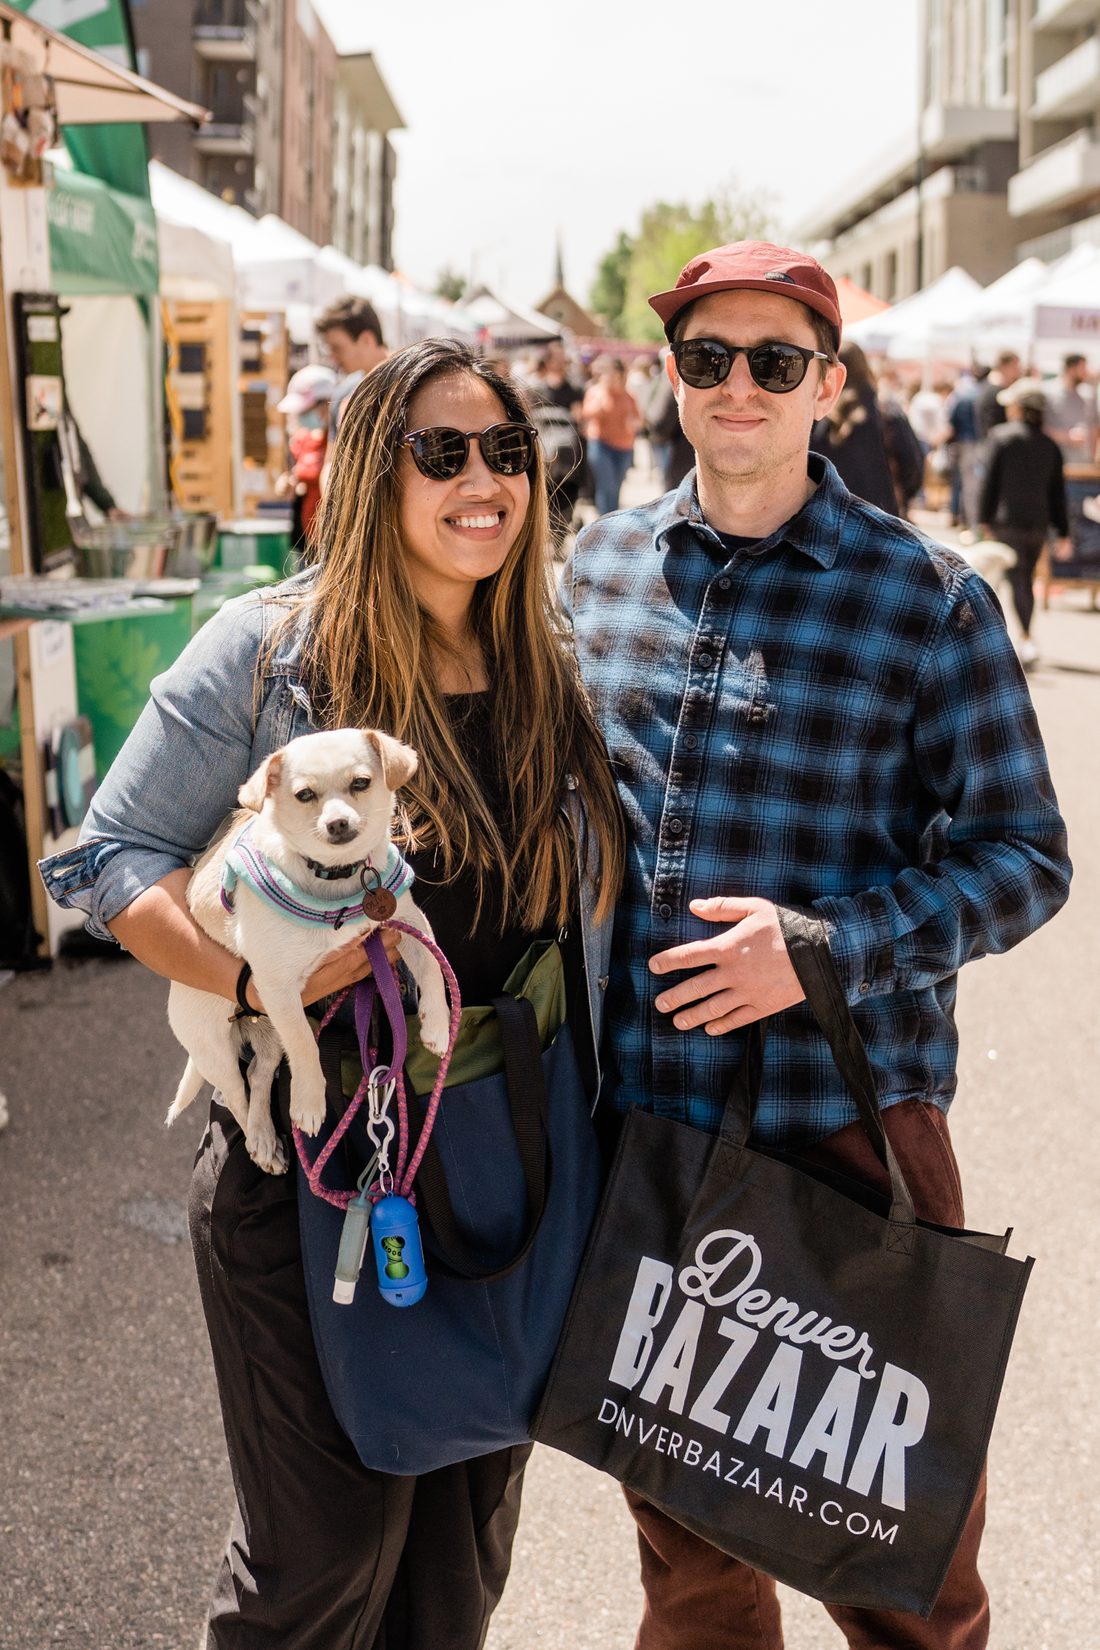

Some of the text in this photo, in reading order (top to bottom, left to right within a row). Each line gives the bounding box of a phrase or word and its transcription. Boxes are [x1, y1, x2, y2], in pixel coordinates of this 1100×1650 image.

[678, 1228, 876, 1379] Denver
[608, 1256, 930, 1512] BAZAAR
[597, 1398, 899, 1545] DNVERBAZAAR.COM
